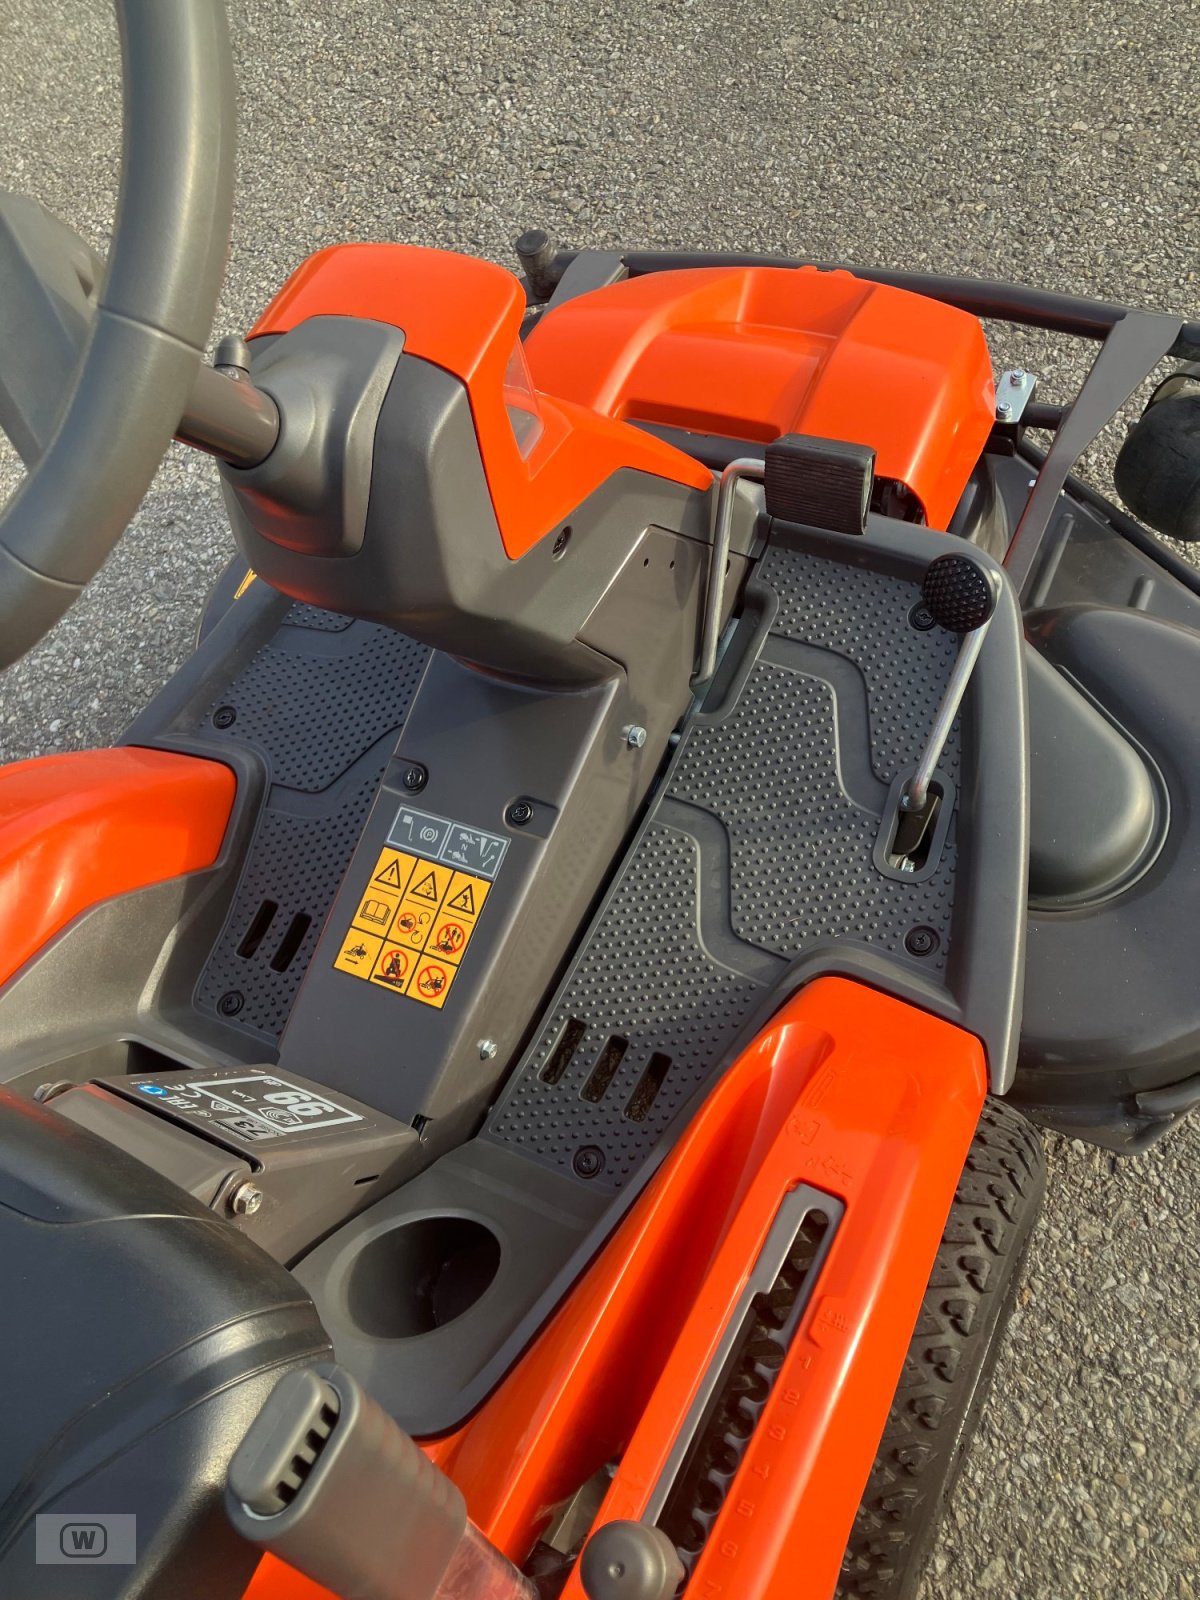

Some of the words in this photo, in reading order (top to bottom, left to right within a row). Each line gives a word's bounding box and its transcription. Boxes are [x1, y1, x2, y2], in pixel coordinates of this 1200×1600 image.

[461, 843, 469, 851] N
[263, 1091, 335, 1116] 99
[234, 1120, 268, 1136] 73
[753, 1464, 770, 1480] 4
